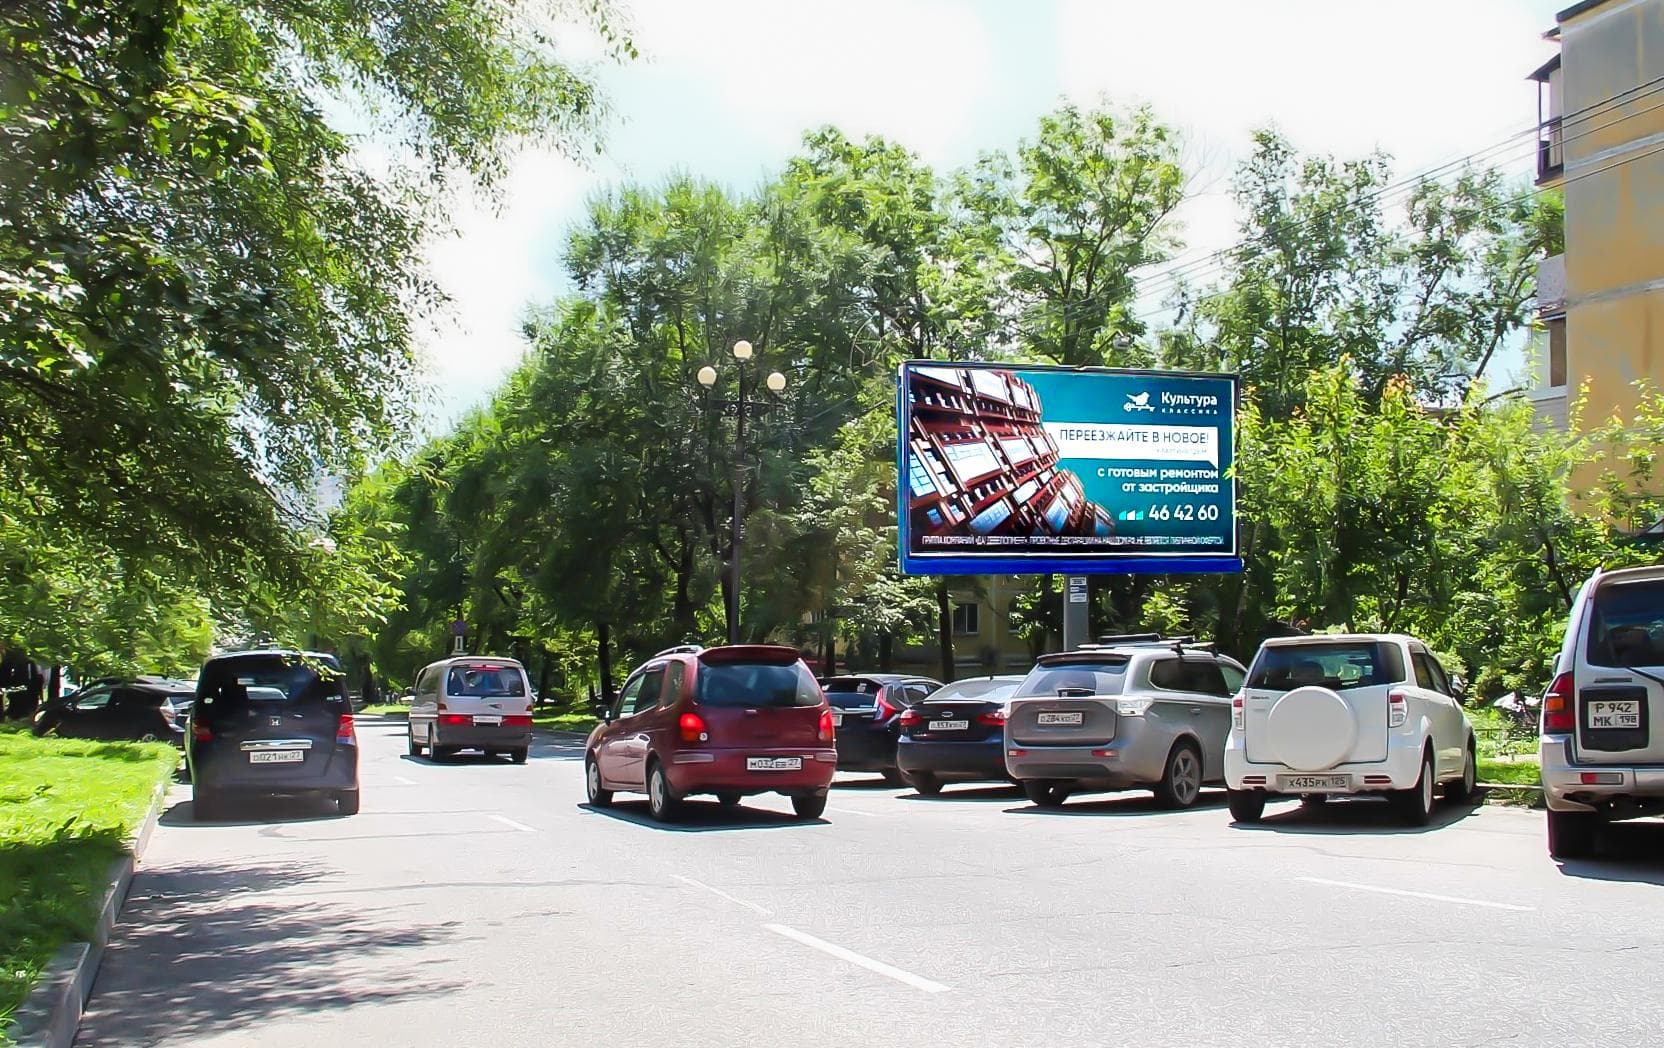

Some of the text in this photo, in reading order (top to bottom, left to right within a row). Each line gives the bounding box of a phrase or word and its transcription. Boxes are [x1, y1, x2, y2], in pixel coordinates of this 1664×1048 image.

[1161, 391, 1218, 407] Культура
[1060, 428, 1209, 444] ПЕРЕЕЗЖАЙТЕ В НОВОЕ!
[1107, 468, 1158, 478] готовым
[1160, 468, 1219, 480] ремонтом
[1121, 481, 1219, 494] от застройщика
[1148, 504, 1219, 521] 46 42 60
[1608, 702, 1632, 713] 942
[1593, 715, 1637, 727] МК 198
[1330, 776, 1346, 785] 125
